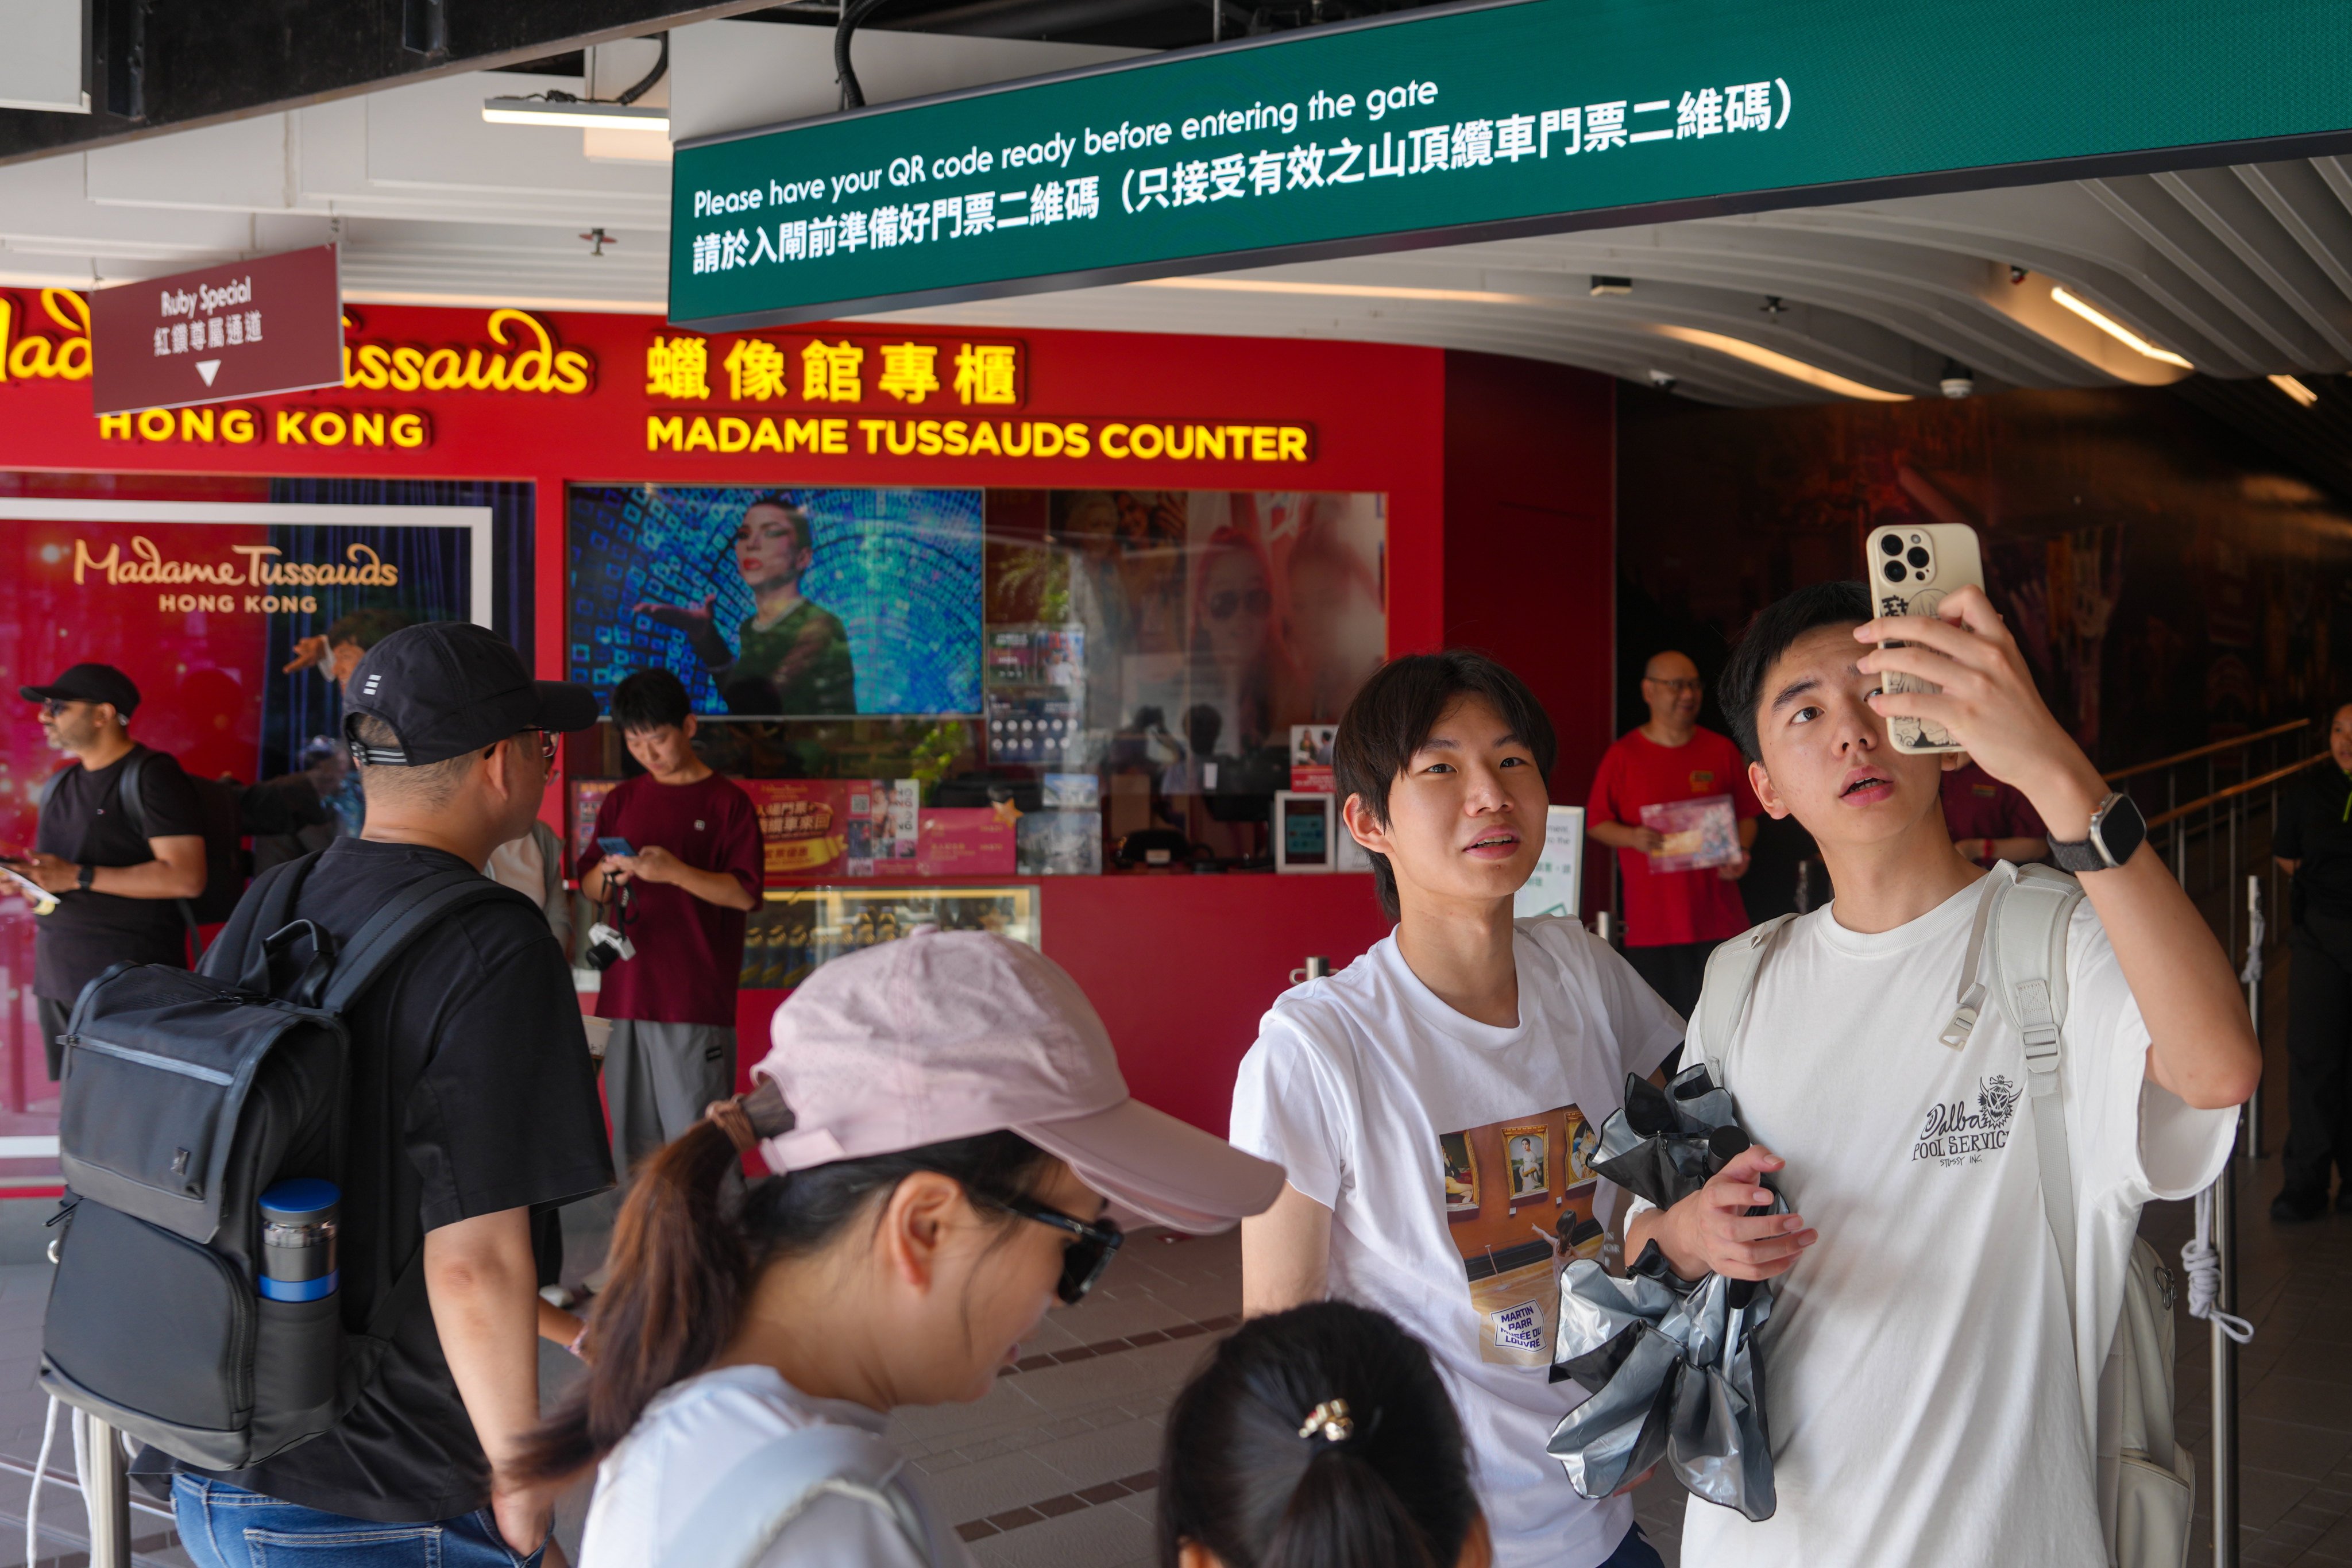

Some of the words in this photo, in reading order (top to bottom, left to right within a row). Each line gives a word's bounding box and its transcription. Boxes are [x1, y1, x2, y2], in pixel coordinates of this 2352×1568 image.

[694, 188, 763, 218] Please
[770, 179, 825, 206] have
[831, 169, 882, 203] your
[888, 155, 926, 186] QR
[932, 146, 994, 179] code
[1002, 132, 1076, 169] ready
[1084, 118, 1172, 155] before
[1181, 101, 1298, 140] entering
[1308, 90, 1356, 121] the
[1366, 79, 1438, 121] gate
[161, 288, 198, 319] Ruby
[199, 276, 252, 315] Special
[646, 337, 1016, 405] 蠟像館專櫃
[99, 407, 254, 443] HONG
[277, 411, 423, 447] KONG
[647, 416, 848, 454] MADAME
[858, 419, 1090, 458] TUSSAUDS
[1099, 423, 1307, 461] COUNTER
[74, 536, 245, 585] Madame
[232, 543, 398, 586] Tussauds
[159, 594, 234, 613] HONG
[244, 596, 317, 613] KONG
[1911, 1138, 1946, 1161] POOL
[1949, 1130, 2010, 1155] SERVIC
[1969, 1154, 1983, 1164] INC.
[1501, 1306, 1534, 1323] MARTIN
[1508, 1317, 1532, 1331] PARR
[1505, 1338, 1541, 1349] LOUVRE
[1532, 1326, 1542, 1338] DU
